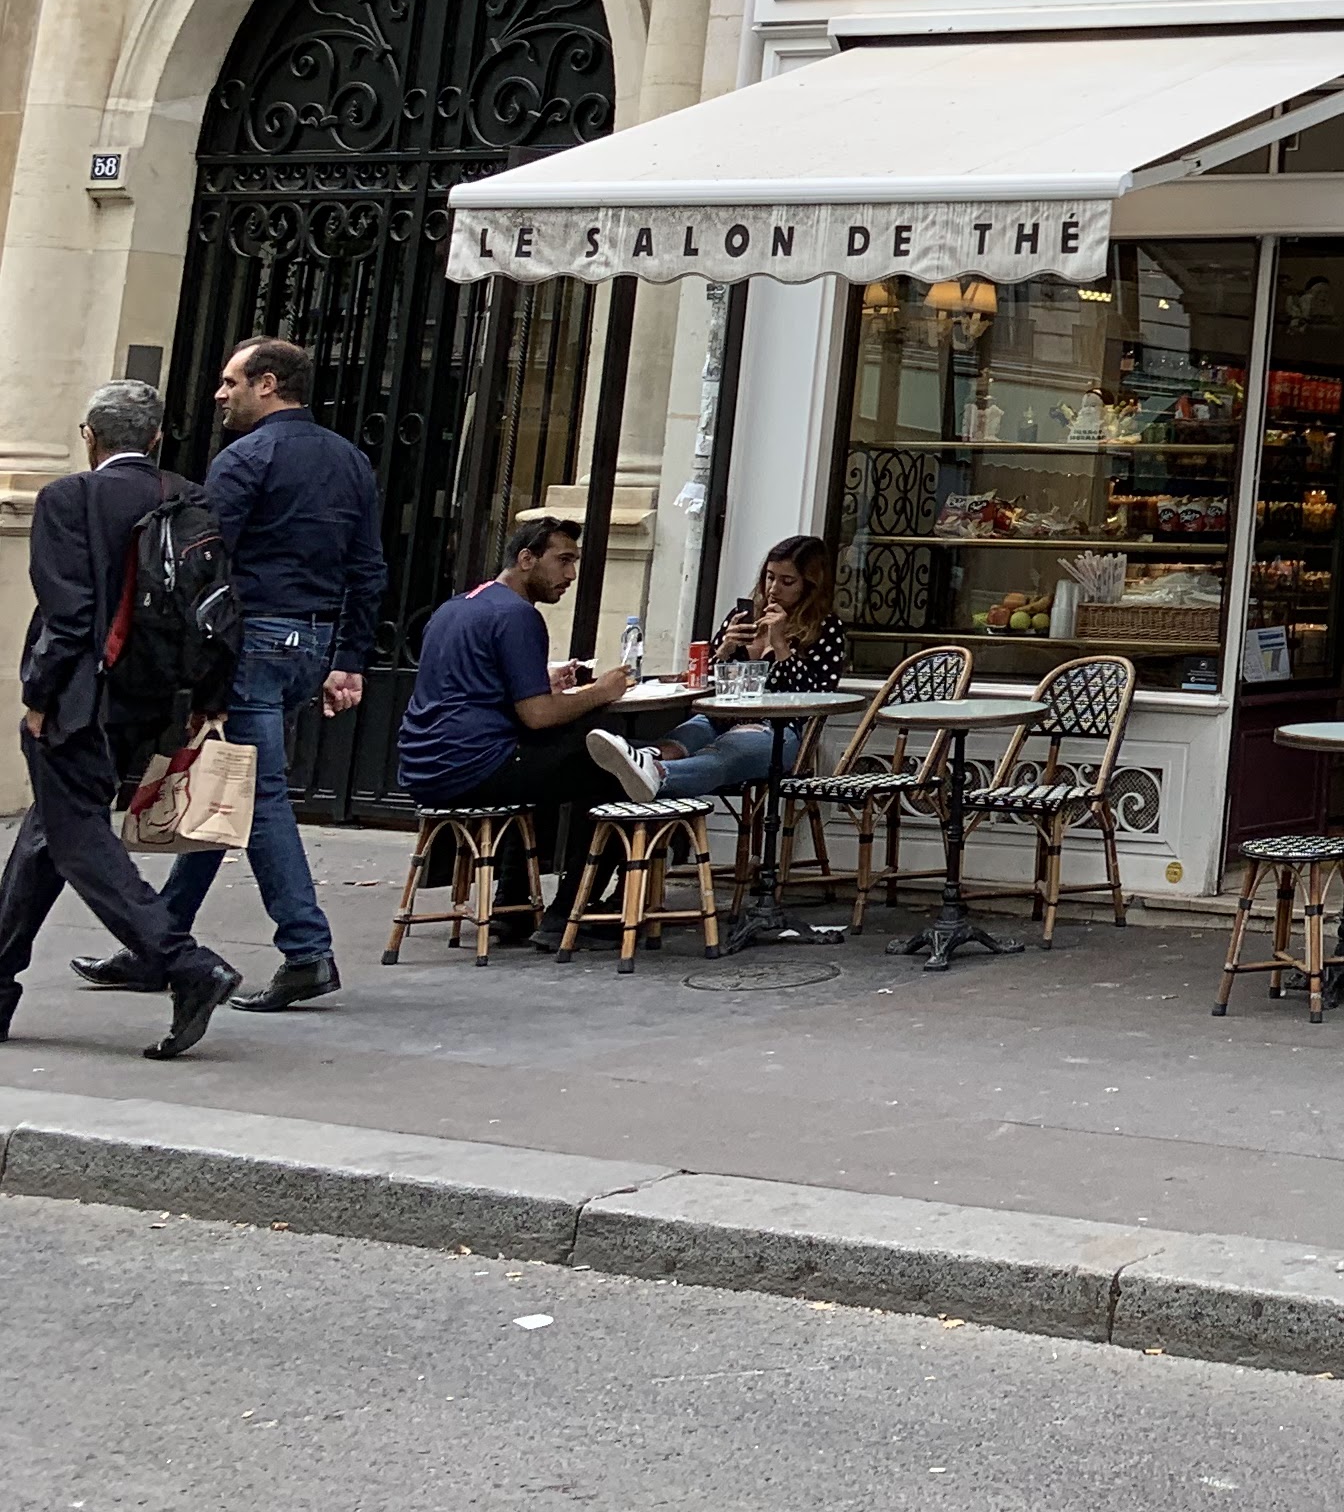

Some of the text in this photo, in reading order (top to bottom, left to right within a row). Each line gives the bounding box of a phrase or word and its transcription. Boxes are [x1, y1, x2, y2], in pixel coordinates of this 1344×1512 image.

[94, 157, 117, 176] 58
[479, 213, 1080, 259] LE SALON DE THÉ
